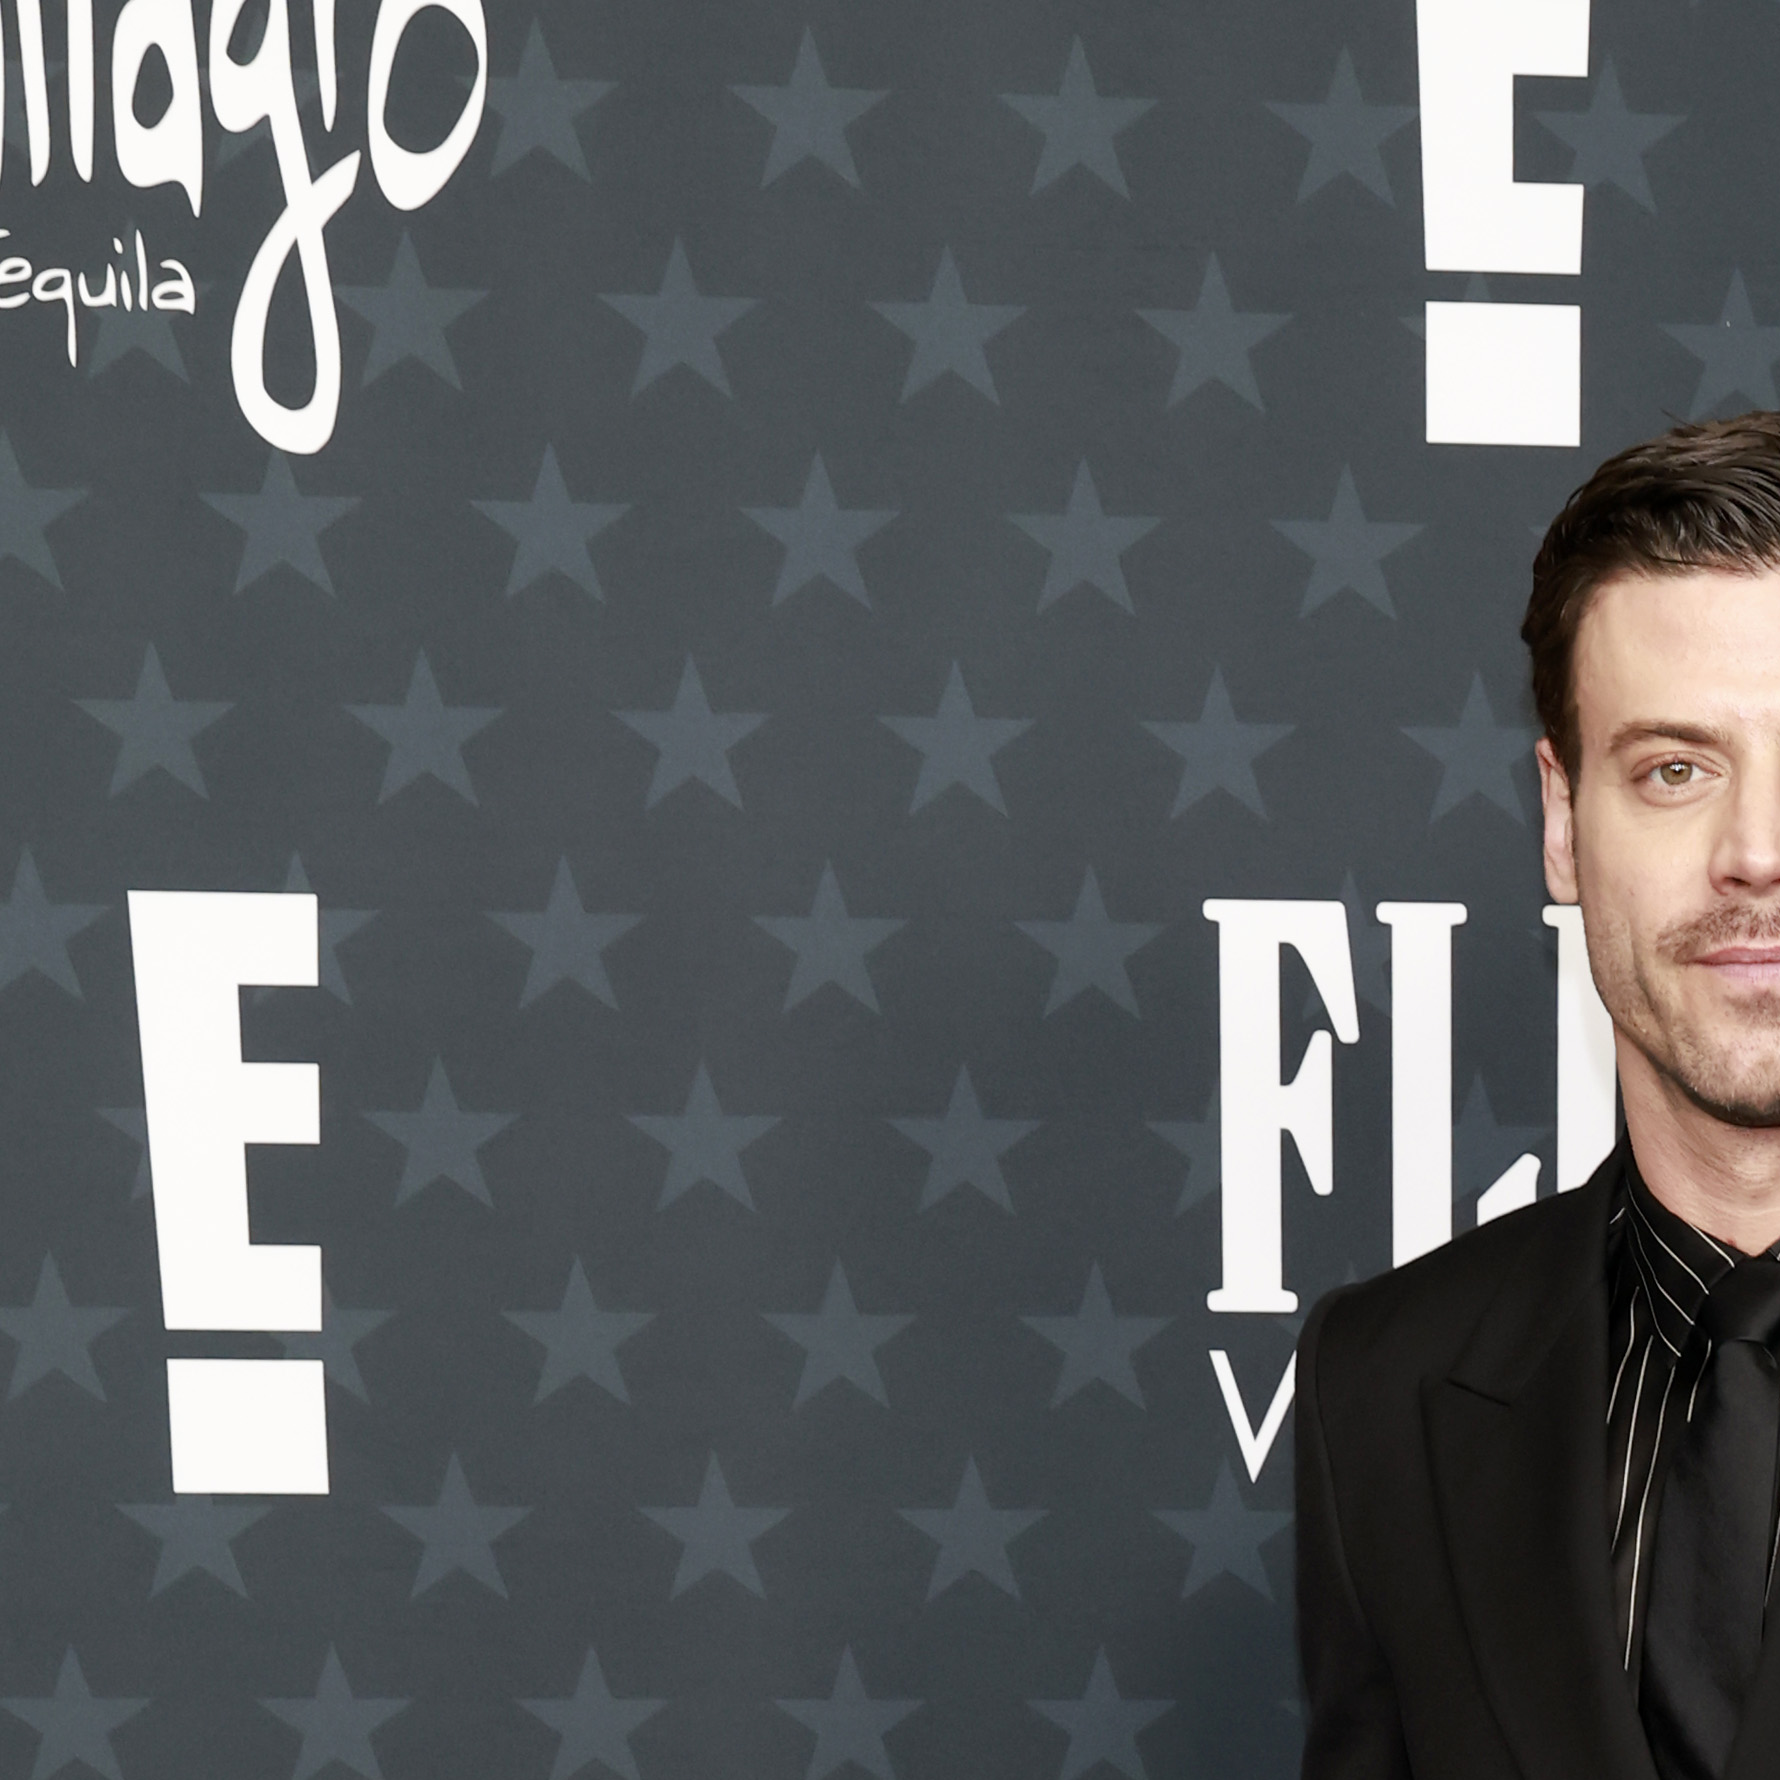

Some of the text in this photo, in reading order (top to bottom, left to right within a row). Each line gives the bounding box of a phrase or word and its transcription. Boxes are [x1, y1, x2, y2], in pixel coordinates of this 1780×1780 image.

[0, 0, 487, 454] ilagro
[0, 229, 196, 368] equila
[1202, 898, 1617, 1313] FIJ
